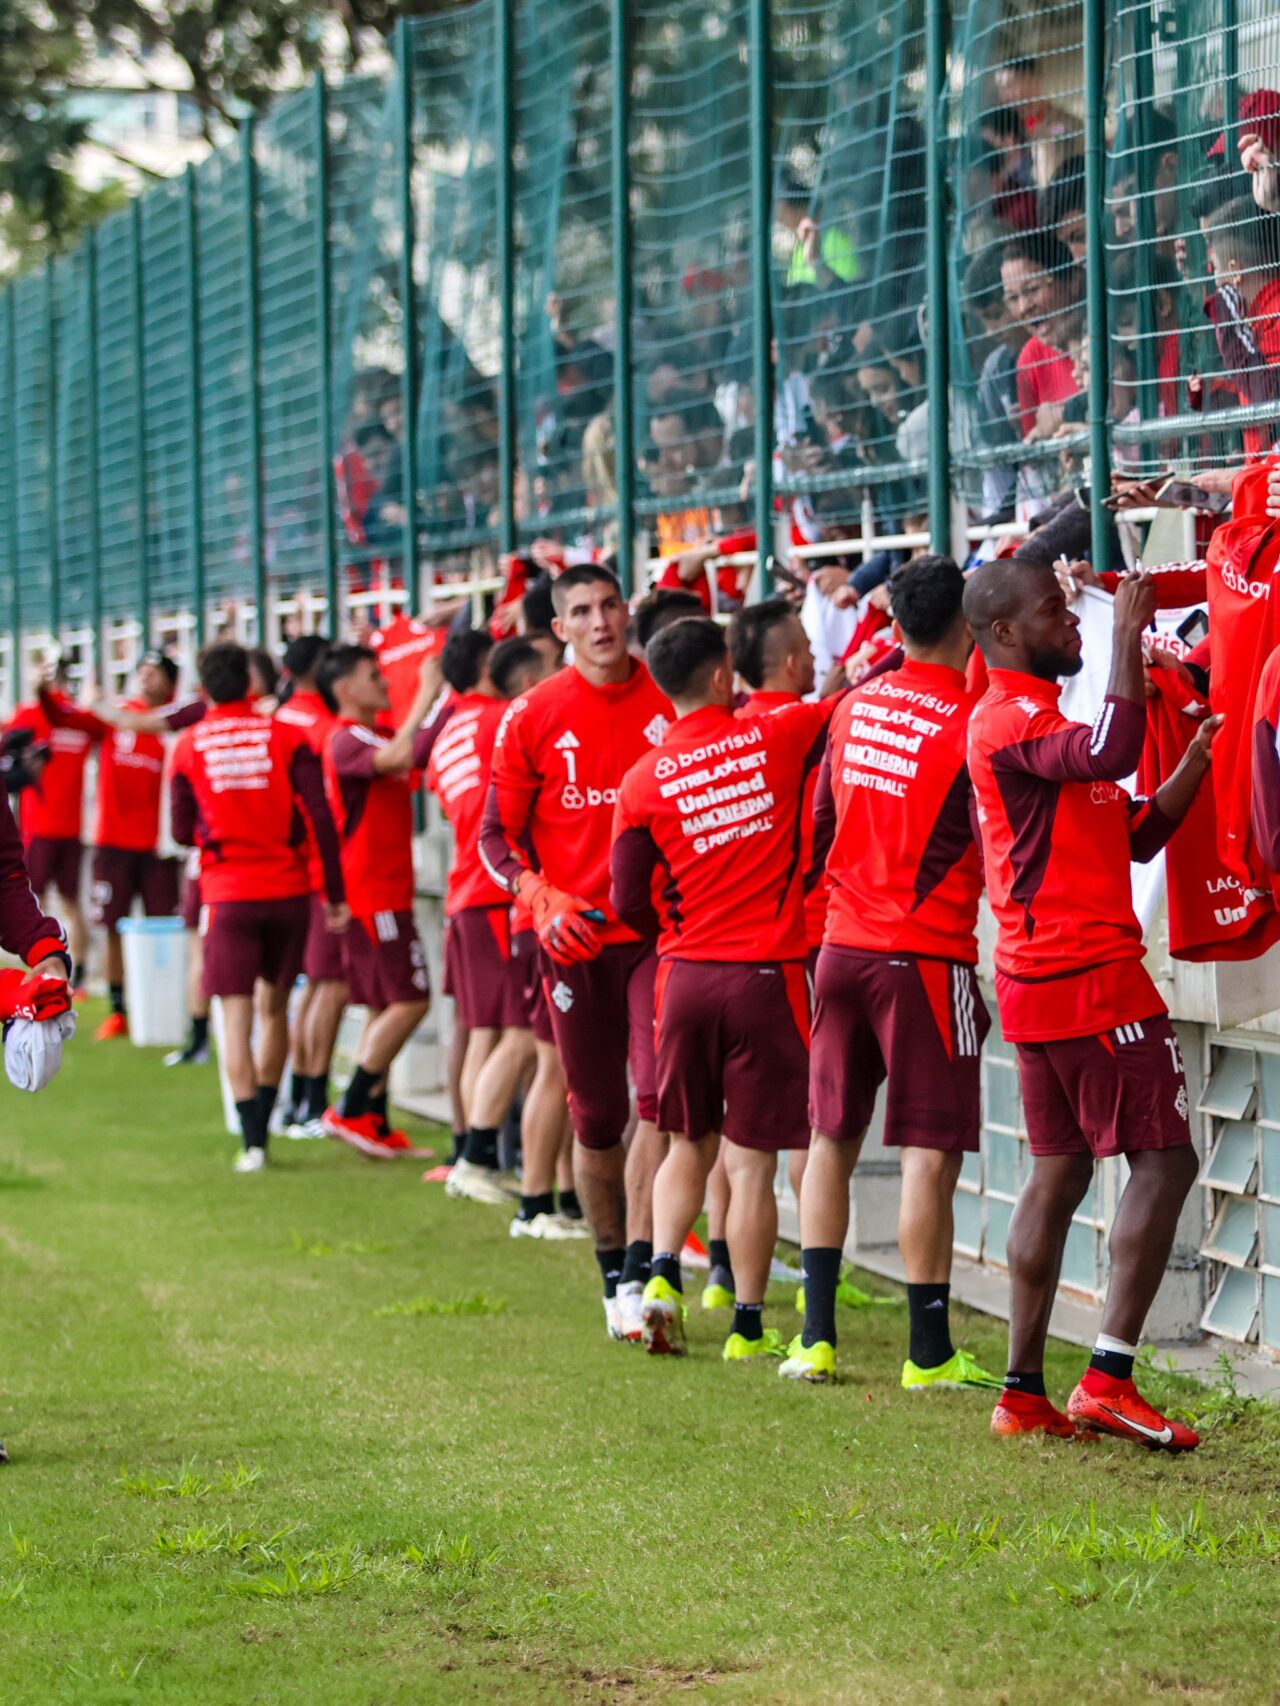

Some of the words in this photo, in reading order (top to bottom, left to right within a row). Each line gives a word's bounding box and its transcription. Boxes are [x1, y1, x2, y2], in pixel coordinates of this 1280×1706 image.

[877, 681, 958, 718] banrisul
[678, 726, 763, 768] banrisul
[850, 720, 922, 753] Unimed
[562, 750, 576, 783] 1
[676, 772, 765, 814] Unimed
